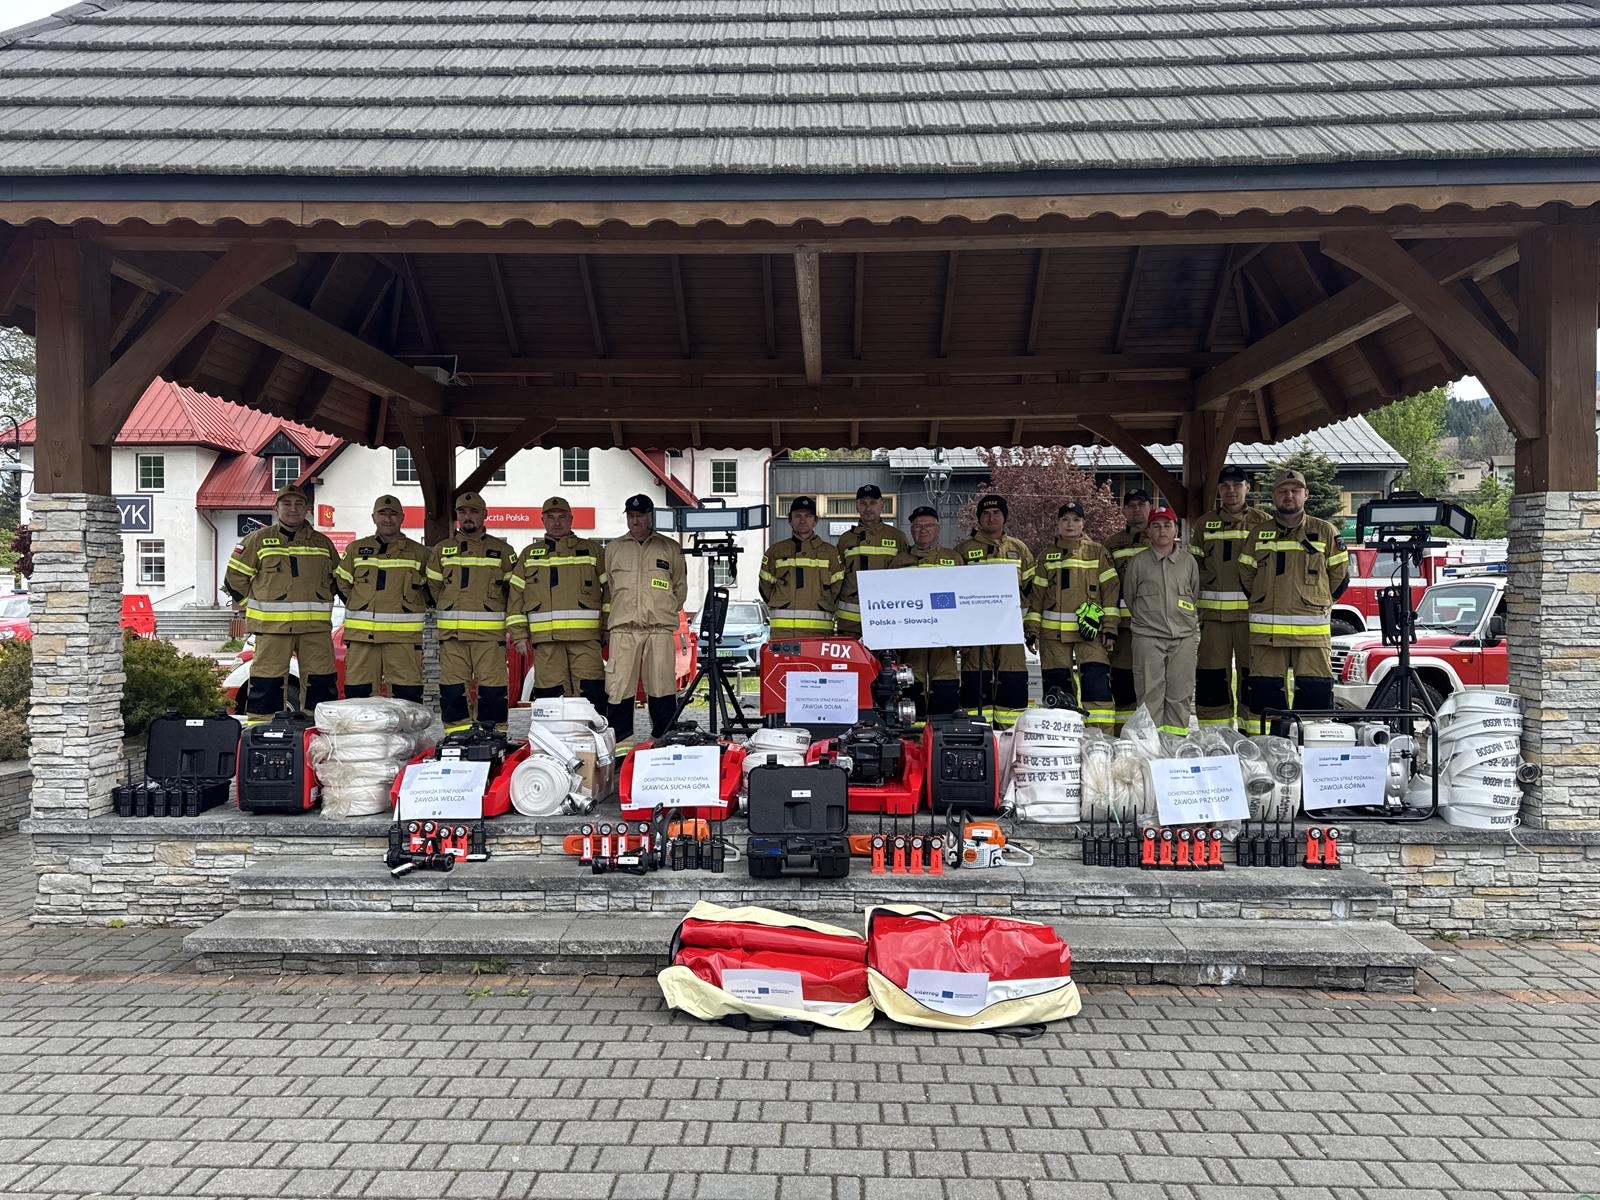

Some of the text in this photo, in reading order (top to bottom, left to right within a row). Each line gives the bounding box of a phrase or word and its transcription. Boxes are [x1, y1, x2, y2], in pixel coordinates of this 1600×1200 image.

[117, 504, 147, 525] YK
[484, 513, 530, 522] oczta Polska
[868, 598, 924, 611] Interreg
[869, 618, 896, 627] Polska
[903, 616, 938, 626] Słowacja
[821, 642, 852, 659] FOX
[1035, 720, 1071, 732] -52-20-ŁA
[1482, 718, 1502, 728] BOGDAN
[1476, 742, 1504, 758] BOGDAN
[1482, 776, 1503, 788] BOGDAN
[1174, 796, 1230, 806] ZAWOJA PRZYSŁOP
[1492, 794, 1510, 806] BOGDAN
